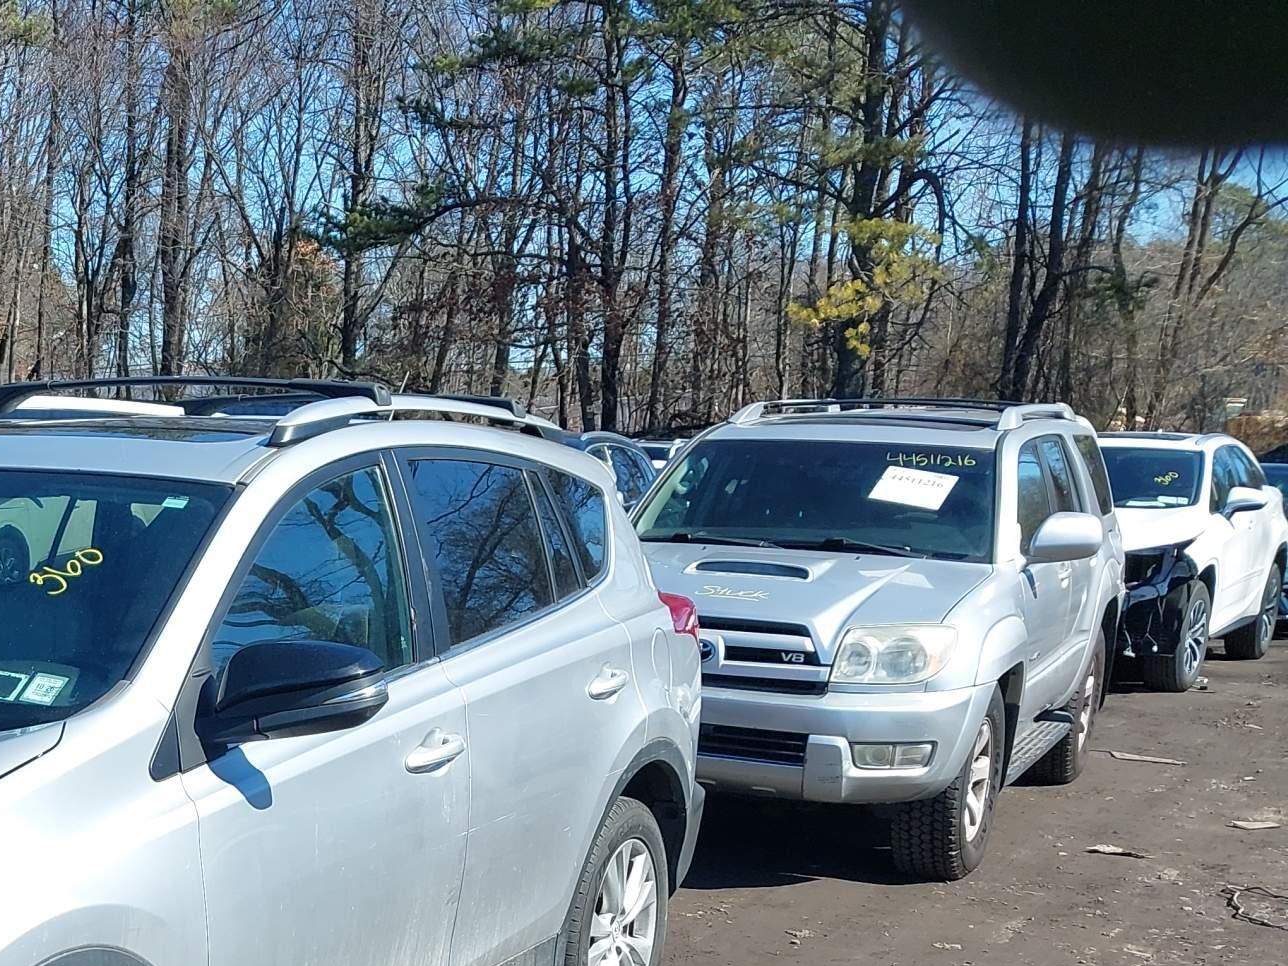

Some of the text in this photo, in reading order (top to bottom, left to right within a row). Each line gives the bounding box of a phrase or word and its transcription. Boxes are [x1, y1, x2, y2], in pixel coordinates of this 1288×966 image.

[886, 452, 976, 467] 44511216
[29, 548, 104, 595] 360
[780, 651, 805, 663] V8
